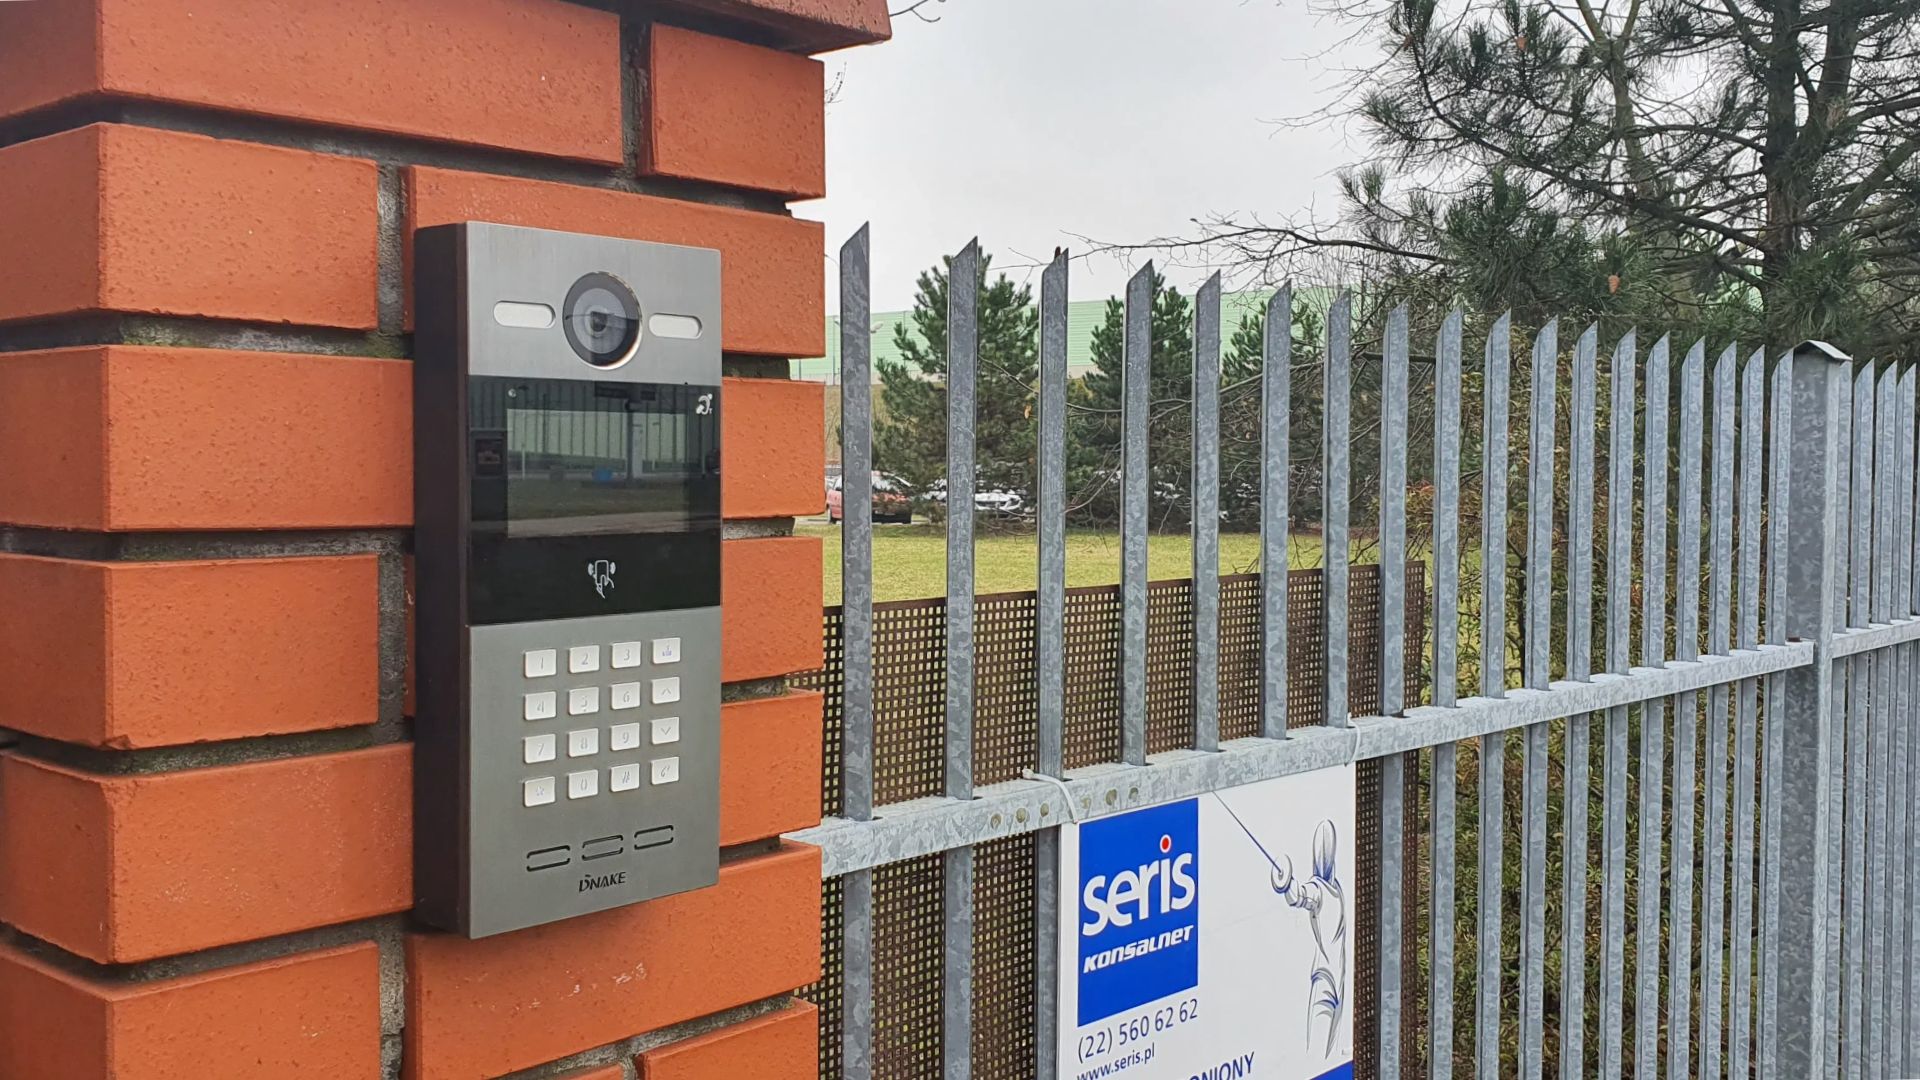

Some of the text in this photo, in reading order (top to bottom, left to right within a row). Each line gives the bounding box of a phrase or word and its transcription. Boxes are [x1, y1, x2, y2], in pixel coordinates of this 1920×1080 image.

[581, 653, 588, 665] 2
[623, 648, 630, 661] 3
[537, 701, 545, 713] 4
[623, 691, 630, 703] 6
[537, 731, 630, 756] 7 8 9
[580, 778, 588, 791] 0
[1082, 834, 1196, 936] seris
[1077, 998, 1198, 1064] (22) 560 62 62
